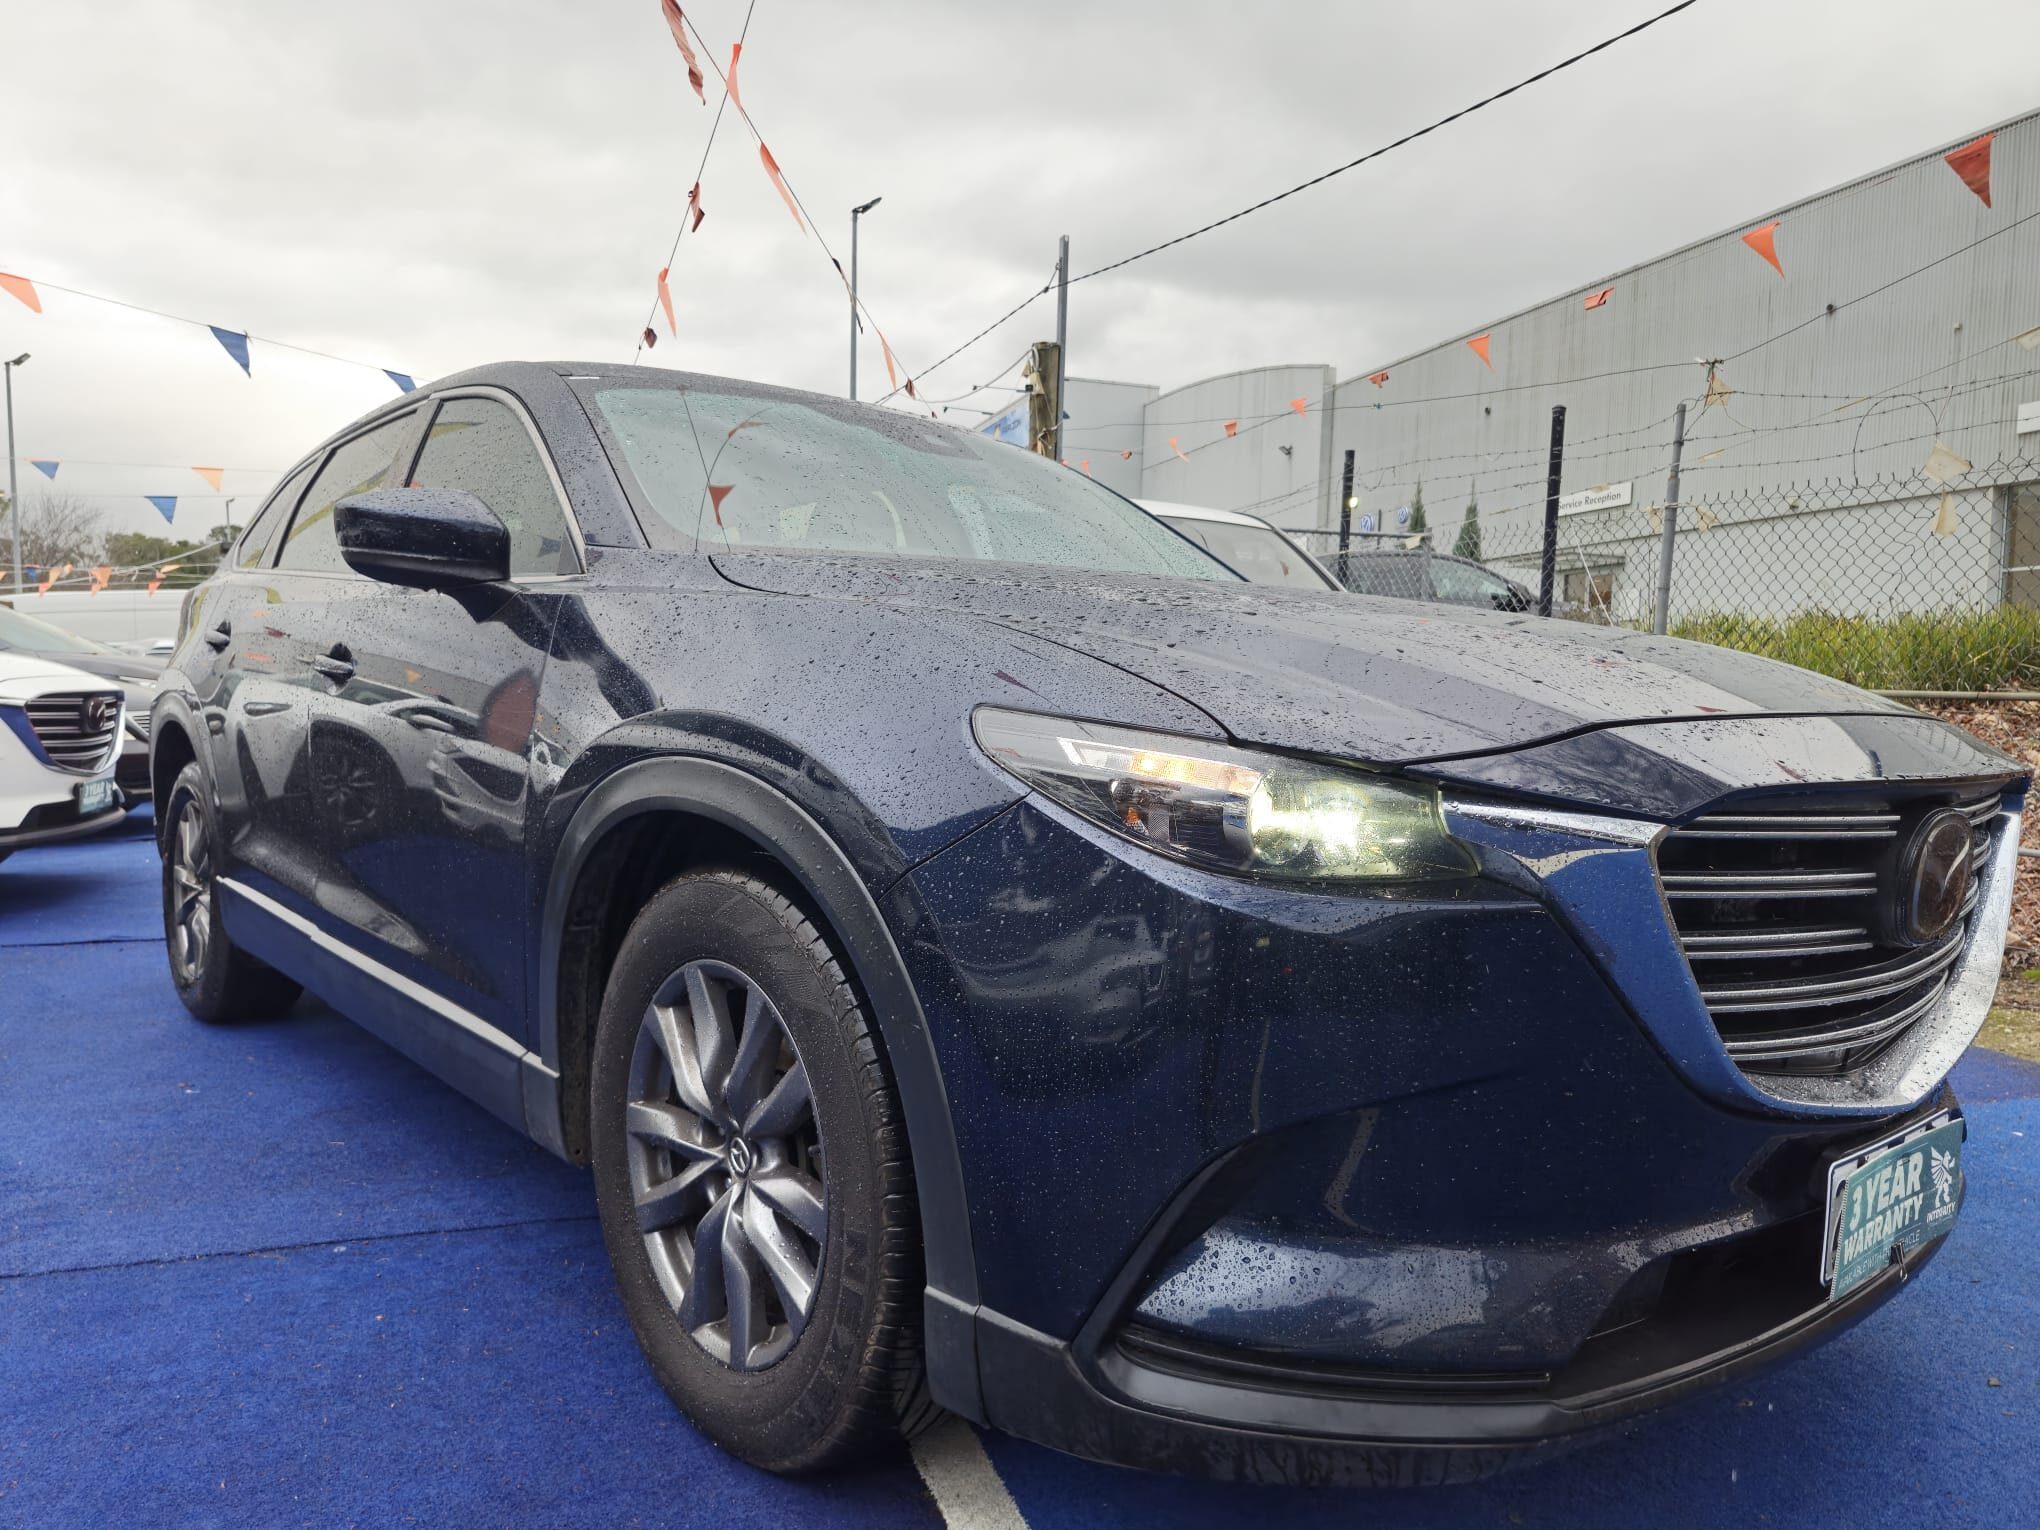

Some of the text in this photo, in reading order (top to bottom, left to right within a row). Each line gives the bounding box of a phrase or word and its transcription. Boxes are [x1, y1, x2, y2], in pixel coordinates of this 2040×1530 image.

[1584, 492, 1622, 505] Reception
[1849, 1151, 1924, 1232] 3 YEAR
[1843, 1192, 1924, 1266] WARRANTY
